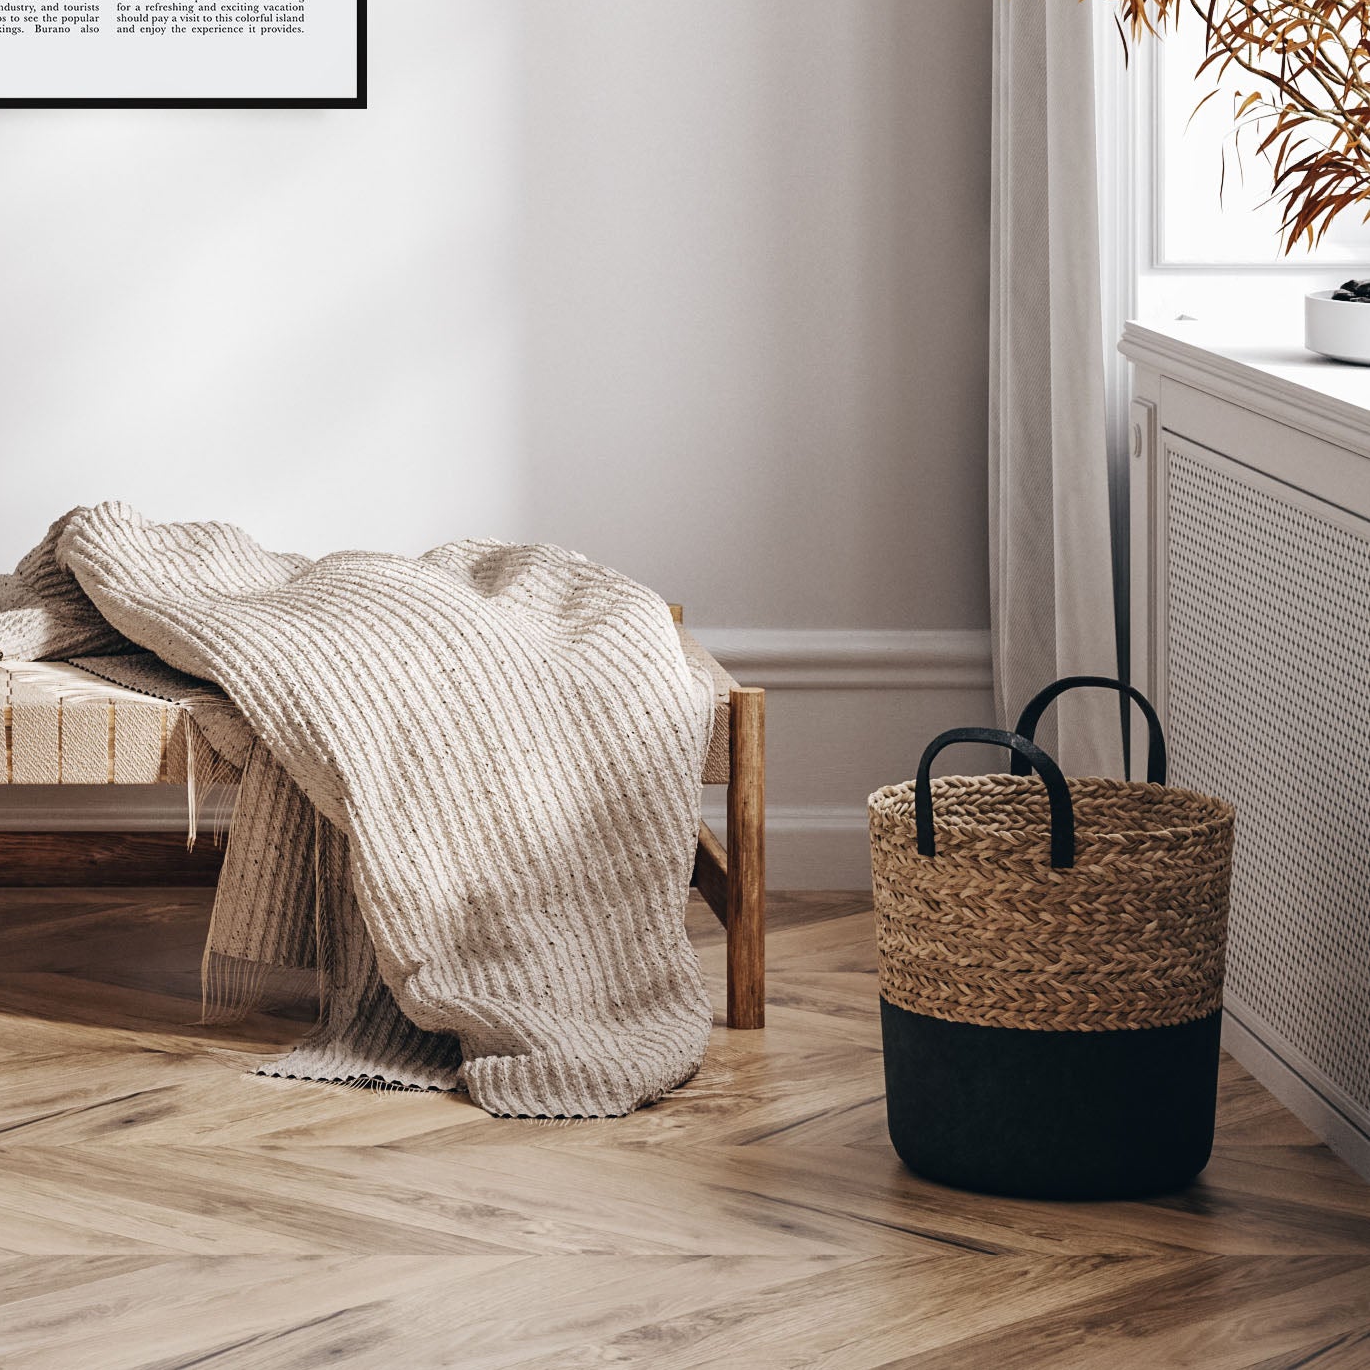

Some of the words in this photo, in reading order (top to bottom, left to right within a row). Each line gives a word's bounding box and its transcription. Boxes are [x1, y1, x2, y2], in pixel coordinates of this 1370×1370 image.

[41, 2, 59, 11] and
[64, 2, 99, 11] tourists
[117, 2, 131, 11] for
[146, 2, 194, 14] refreshing
[198, 2, 216, 11] and
[221, 2, 259, 14] exciting
[264, 2, 304, 11] vacation
[35, 24, 70, 33] Burano
[81, 24, 99, 33] also
[117, 24, 134, 33] and
[140, 24, 166, 36] enjoy
[172, 24, 186, 33] the
[192, 24, 243, 36] experience
[249, 24, 255, 33] it
[261, 24, 304, 36] provides.
